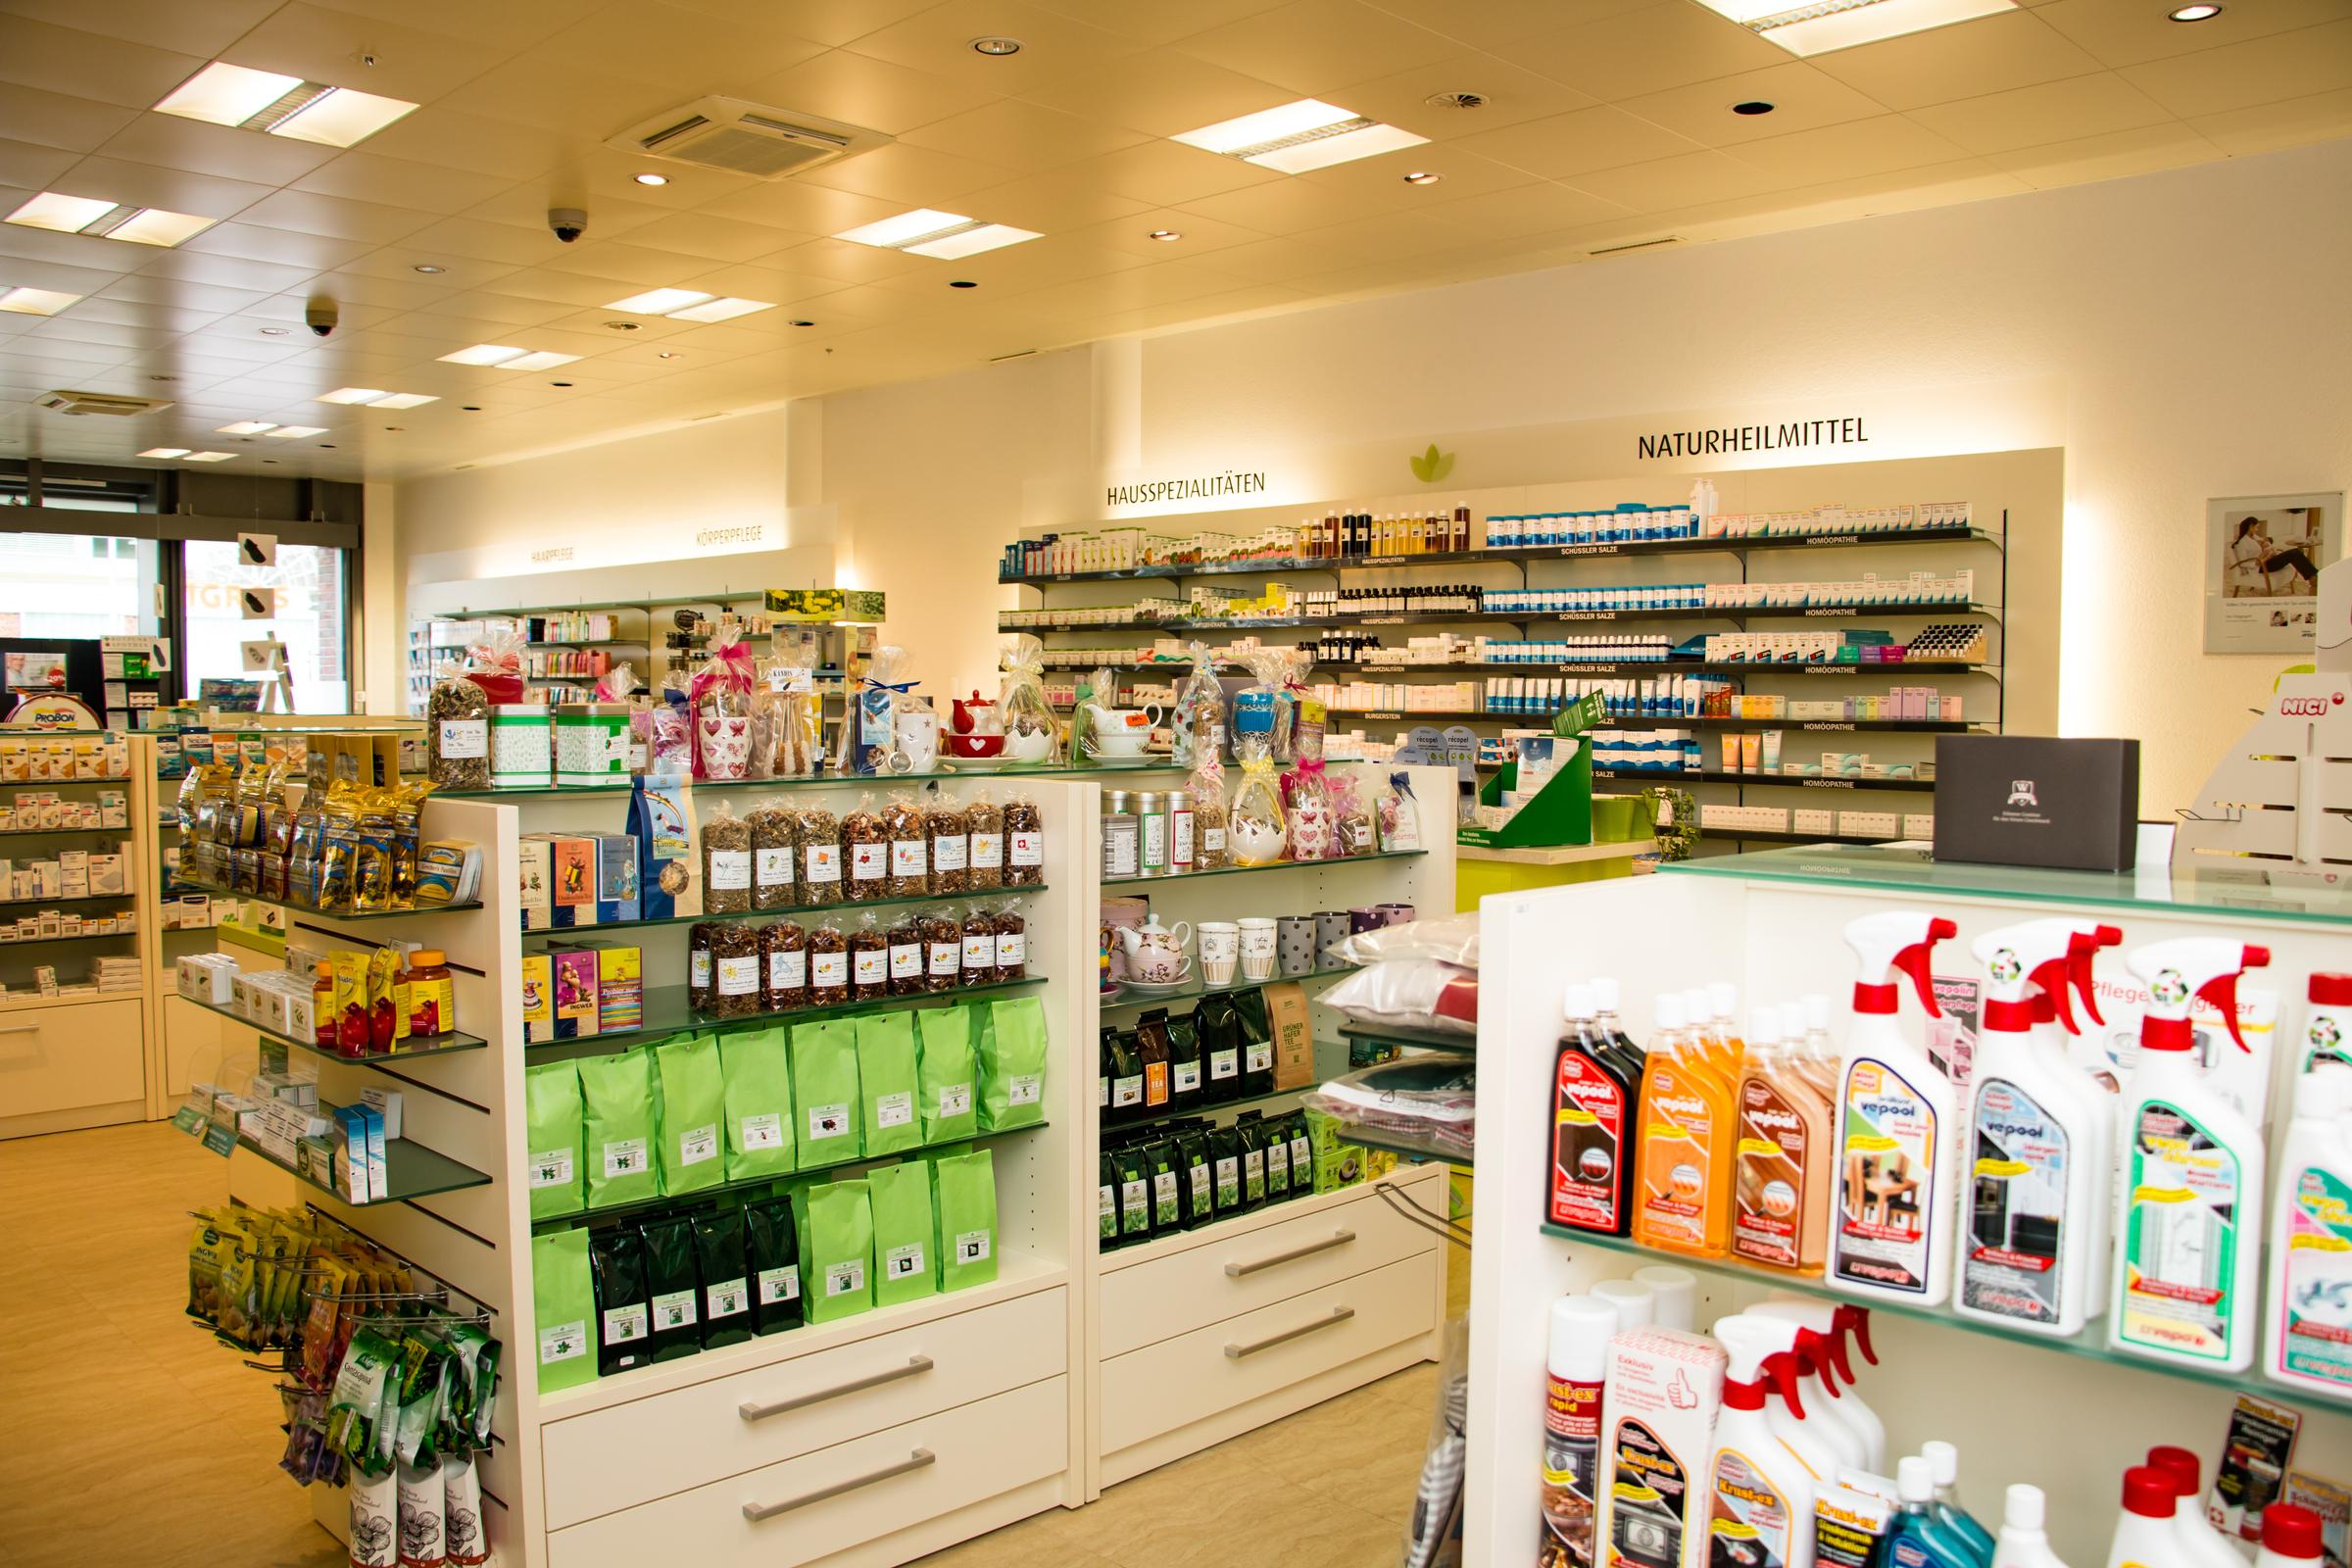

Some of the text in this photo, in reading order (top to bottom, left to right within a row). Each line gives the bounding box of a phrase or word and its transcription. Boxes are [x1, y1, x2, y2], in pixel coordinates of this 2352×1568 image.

[1639, 417, 1868, 461] NATURHEILMITTEL
[1107, 471, 1265, 507] HAUSSPEZIALITÄTEN
[697, 525, 762, 547] KÖRPERPFLEGE
[1806, 535, 1858, 545] HOMÖOPATHIE
[531, 547, 573, 564] HAARPFLEGE
[1561, 546, 1597, 555] SCHÜSSLER
[1559, 612, 1595, 620] SCHÜSSLER
[1559, 663, 1595, 672] SCHÜSSLER
[1805, 665, 1856, 674] HOMÖOPATHIE
[2281, 698, 2328, 716] NICI
[1803, 722, 1855, 731] HOMÖOPATHIE
[1803, 779, 1854, 789] HOMÖOPATHIE
[1861, 1102, 1915, 1116] vepool
[1748, 1109, 1797, 1129] vepool
[1986, 1122, 2042, 1142] vepool
[1549, 1396, 1579, 1412] rapid
[1718, 1478, 1775, 1507] Krust-ex
[1816, 1498, 1878, 1530] Krust-ex
